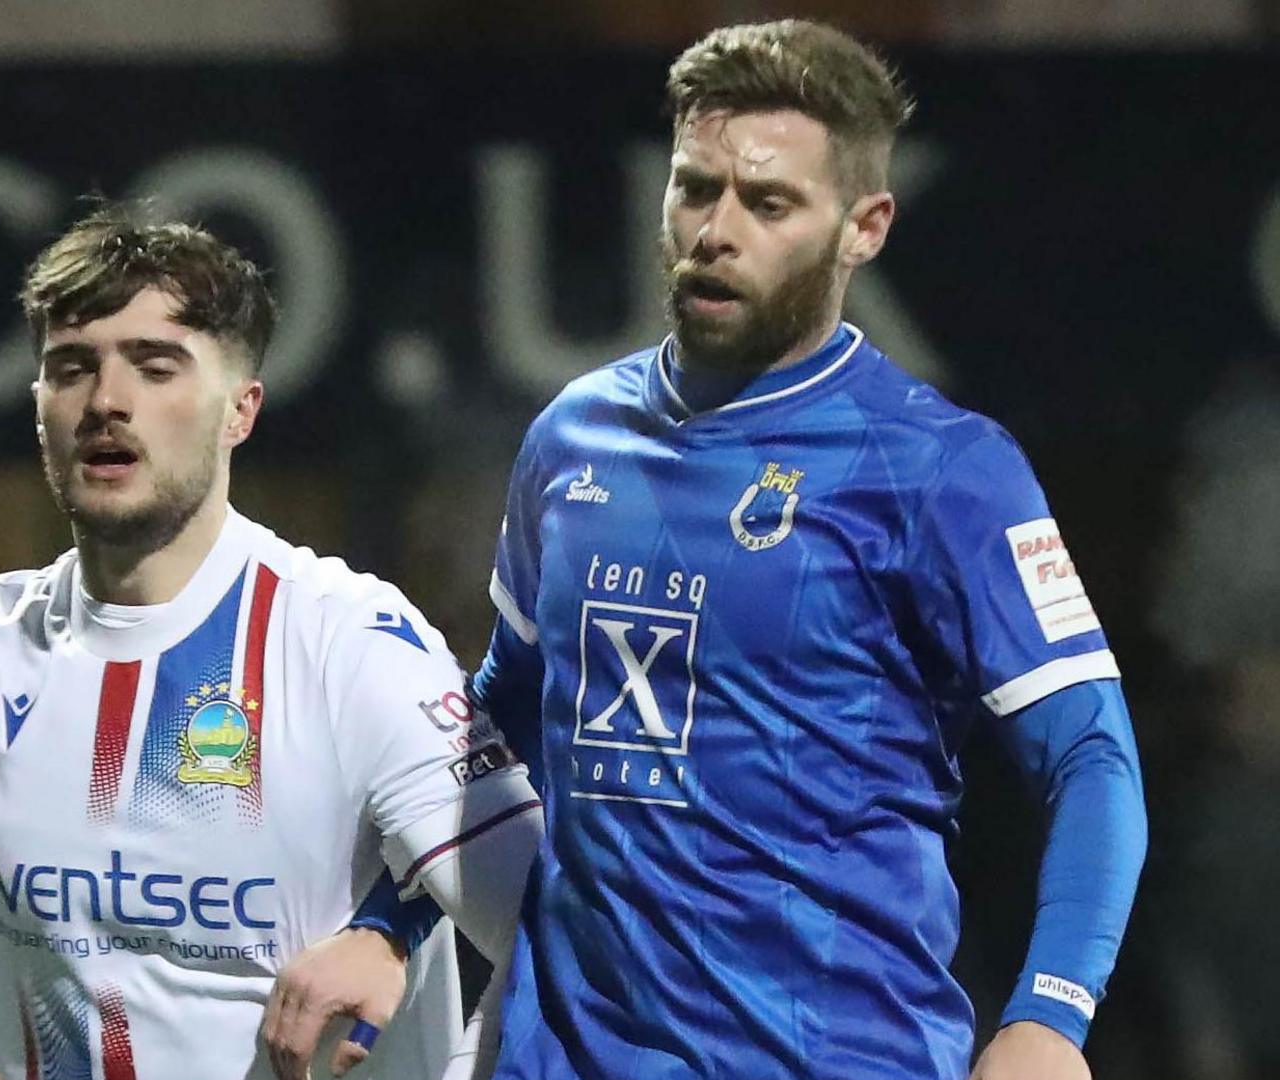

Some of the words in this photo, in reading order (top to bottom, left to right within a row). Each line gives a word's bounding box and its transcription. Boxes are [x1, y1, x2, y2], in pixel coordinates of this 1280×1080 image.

[565, 481, 611, 504] Swifts
[1017, 534, 1066, 560] RAM
[587, 554, 644, 595] ten
[666, 571, 707, 610] sq
[583, 617, 683, 739] X
[418, 691, 475, 733] to
[97, 934, 151, 955] your
